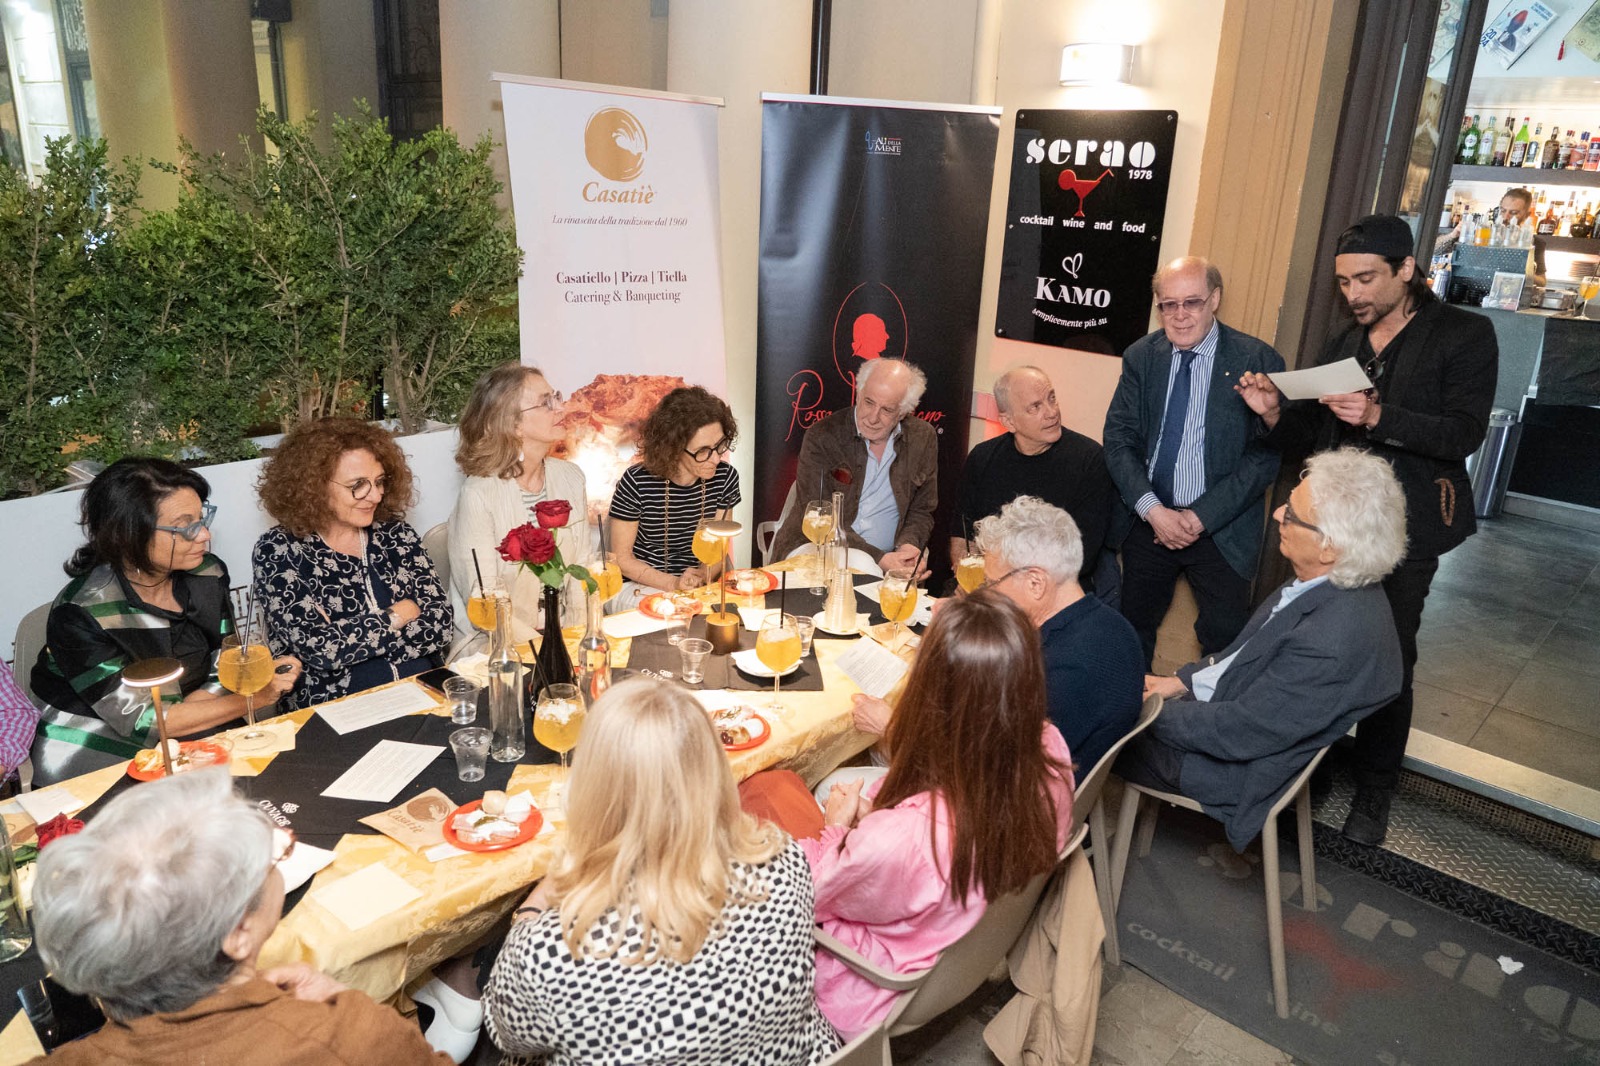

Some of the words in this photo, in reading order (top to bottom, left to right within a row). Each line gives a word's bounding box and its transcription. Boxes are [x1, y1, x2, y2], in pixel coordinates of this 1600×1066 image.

[874, 144, 901, 152] MENTE
[1026, 138, 1156, 168] serao
[1128, 169, 1153, 180] 1978
[582, 181, 654, 204] Casatiè
[552, 214, 563, 224] La
[563, 215, 597, 225] rinascita
[598, 215, 617, 225] della
[617, 216, 654, 227] tradizione
[654, 216, 668, 226] dal
[668, 217, 688, 227] 1960
[1019, 215, 1054, 226] cocktail
[1062, 217, 1085, 228] wine
[1093, 220, 1113, 231] and
[1122, 221, 1146, 234] food
[556, 271, 611, 284] Casatiello
[621, 271, 648, 283] Pizza
[657, 270, 687, 283] Tiella
[564, 290, 611, 306] Catering
[612, 290, 622, 302] &
[625, 289, 682, 305] Banqueting
[1034, 276, 1111, 308] KAMO
[1031, 307, 1083, 328] semplicemente
[1084, 317, 1097, 330] più
[1098, 317, 1108, 326] su
[1126, 920, 1237, 983] cocktail
